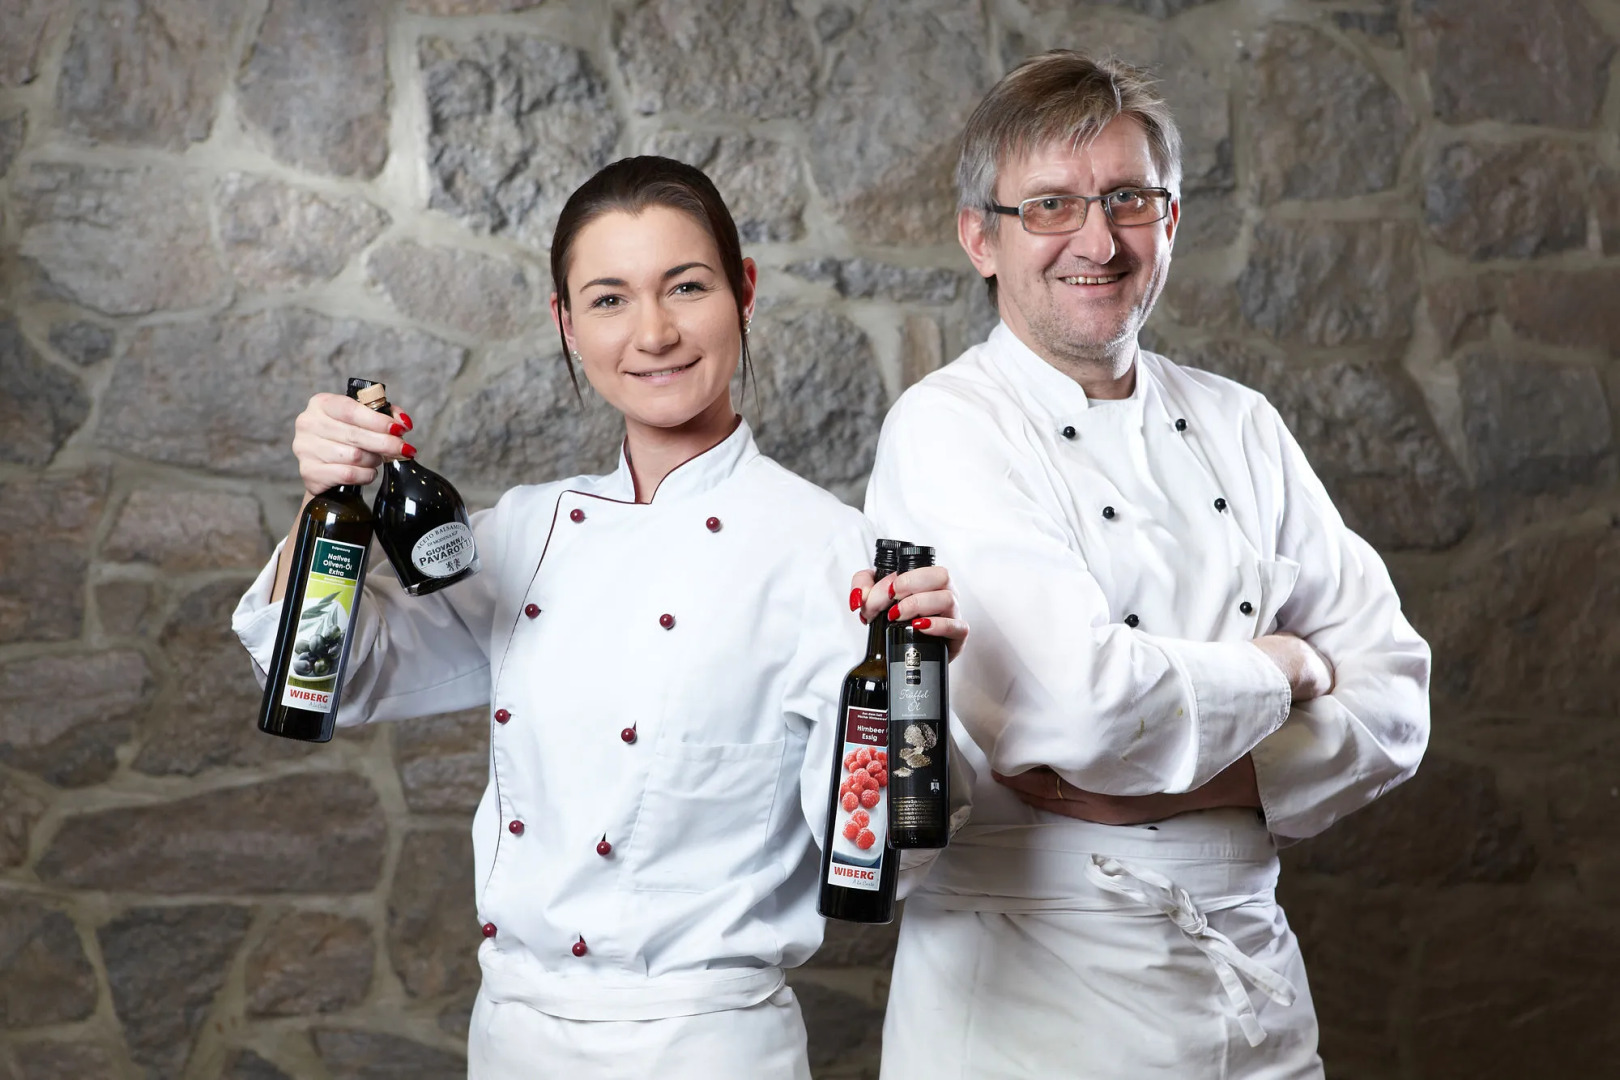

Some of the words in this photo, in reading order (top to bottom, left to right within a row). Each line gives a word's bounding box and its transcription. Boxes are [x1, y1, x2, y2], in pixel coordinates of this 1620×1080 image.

[417, 533, 434, 550] ACETO
[426, 536, 464, 556] GIOVANNA
[328, 553, 350, 563] Natives
[419, 538, 472, 566] PAVAROTTI
[329, 568, 344, 576] Extra
[290, 689, 328, 703] WIBERG
[857, 725, 884, 734] Himbeer
[862, 733, 878, 742] Essig
[834, 866, 874, 880] WIBERG
